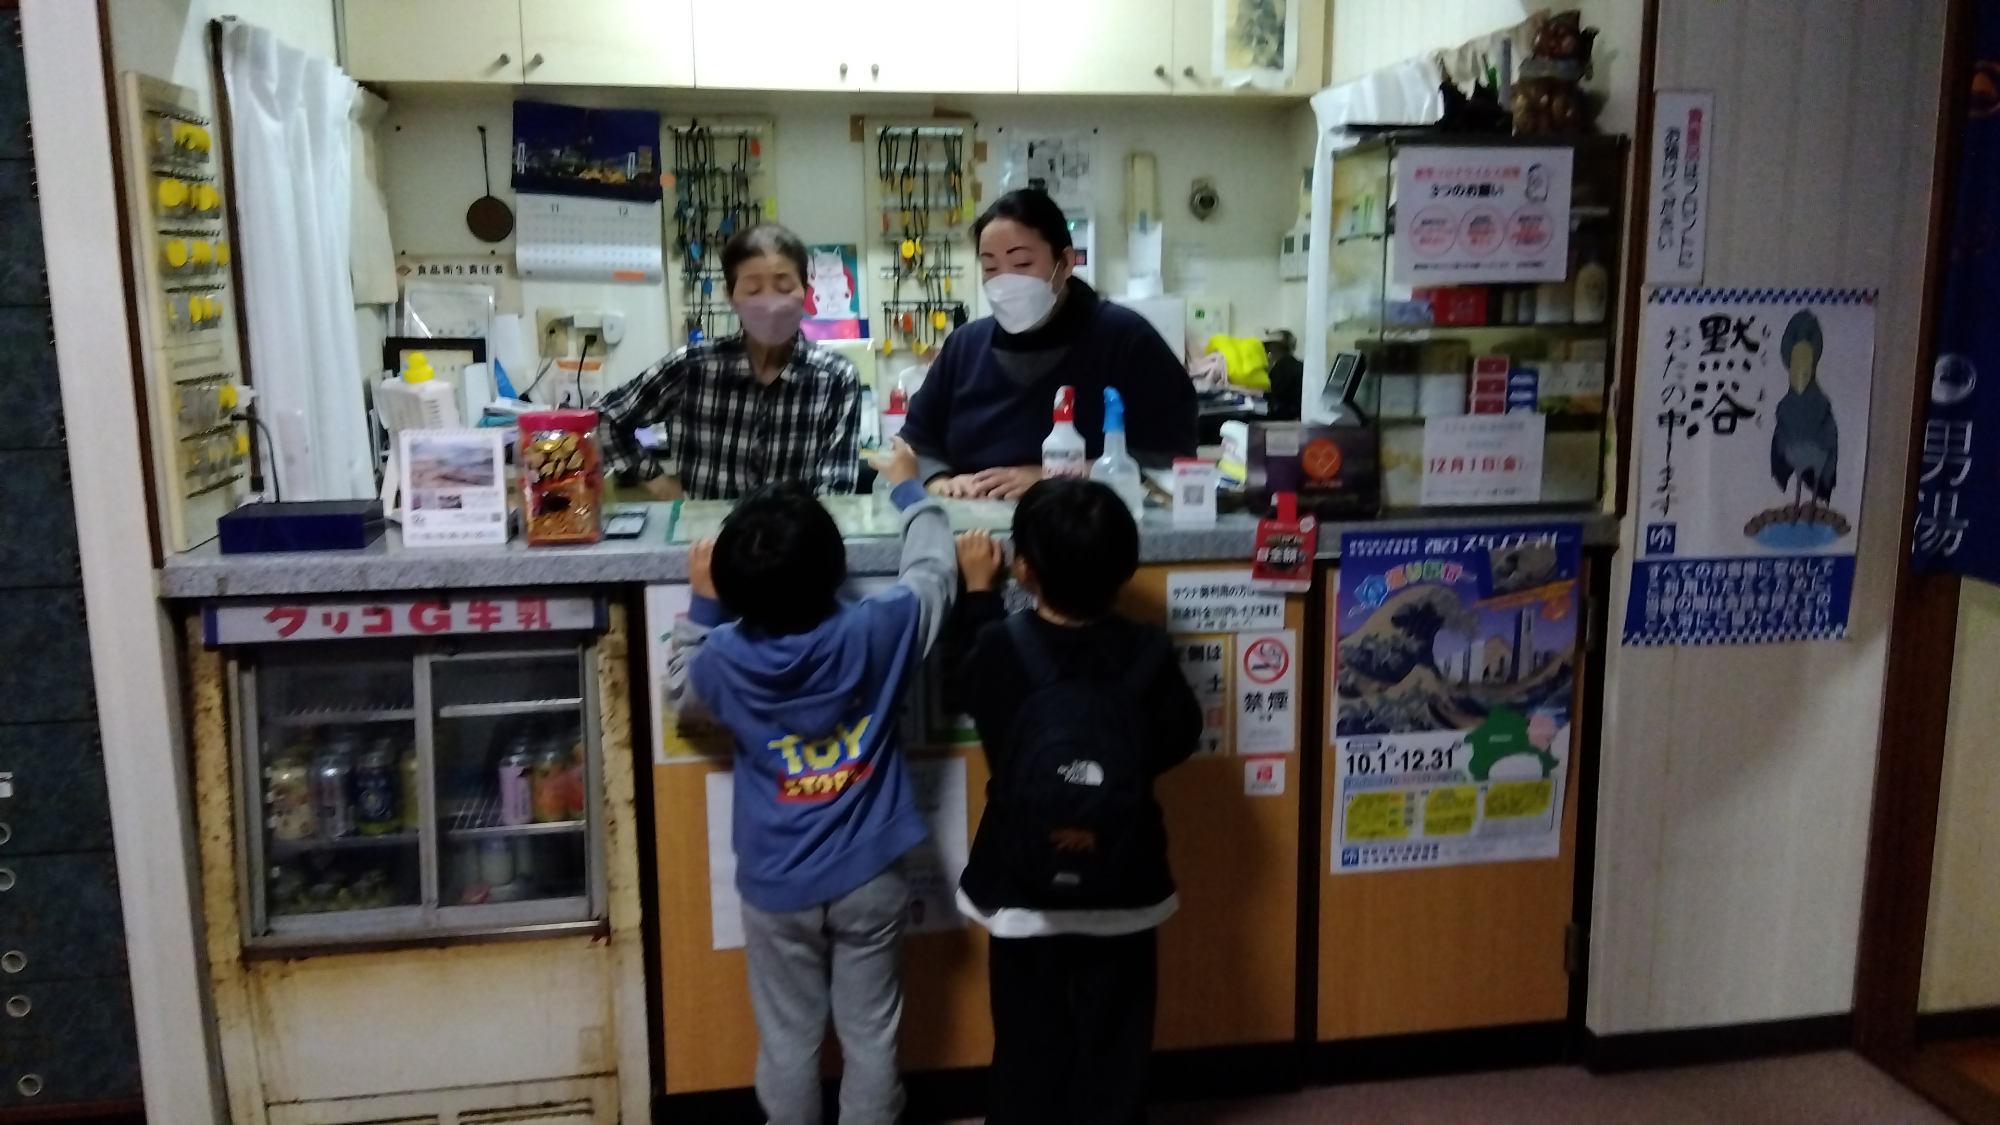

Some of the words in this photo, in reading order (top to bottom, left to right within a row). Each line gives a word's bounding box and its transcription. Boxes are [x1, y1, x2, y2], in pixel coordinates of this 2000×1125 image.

[1686, 313, 1761, 440] 黙浴
[1911, 419, 1974, 557] 男湯
[1244, 690, 1288, 713] 禁煙
[767, 714, 872, 774] TOY
[1346, 752, 1388, 775] 10.1
[1401, 747, 1454, 773] 12.31
